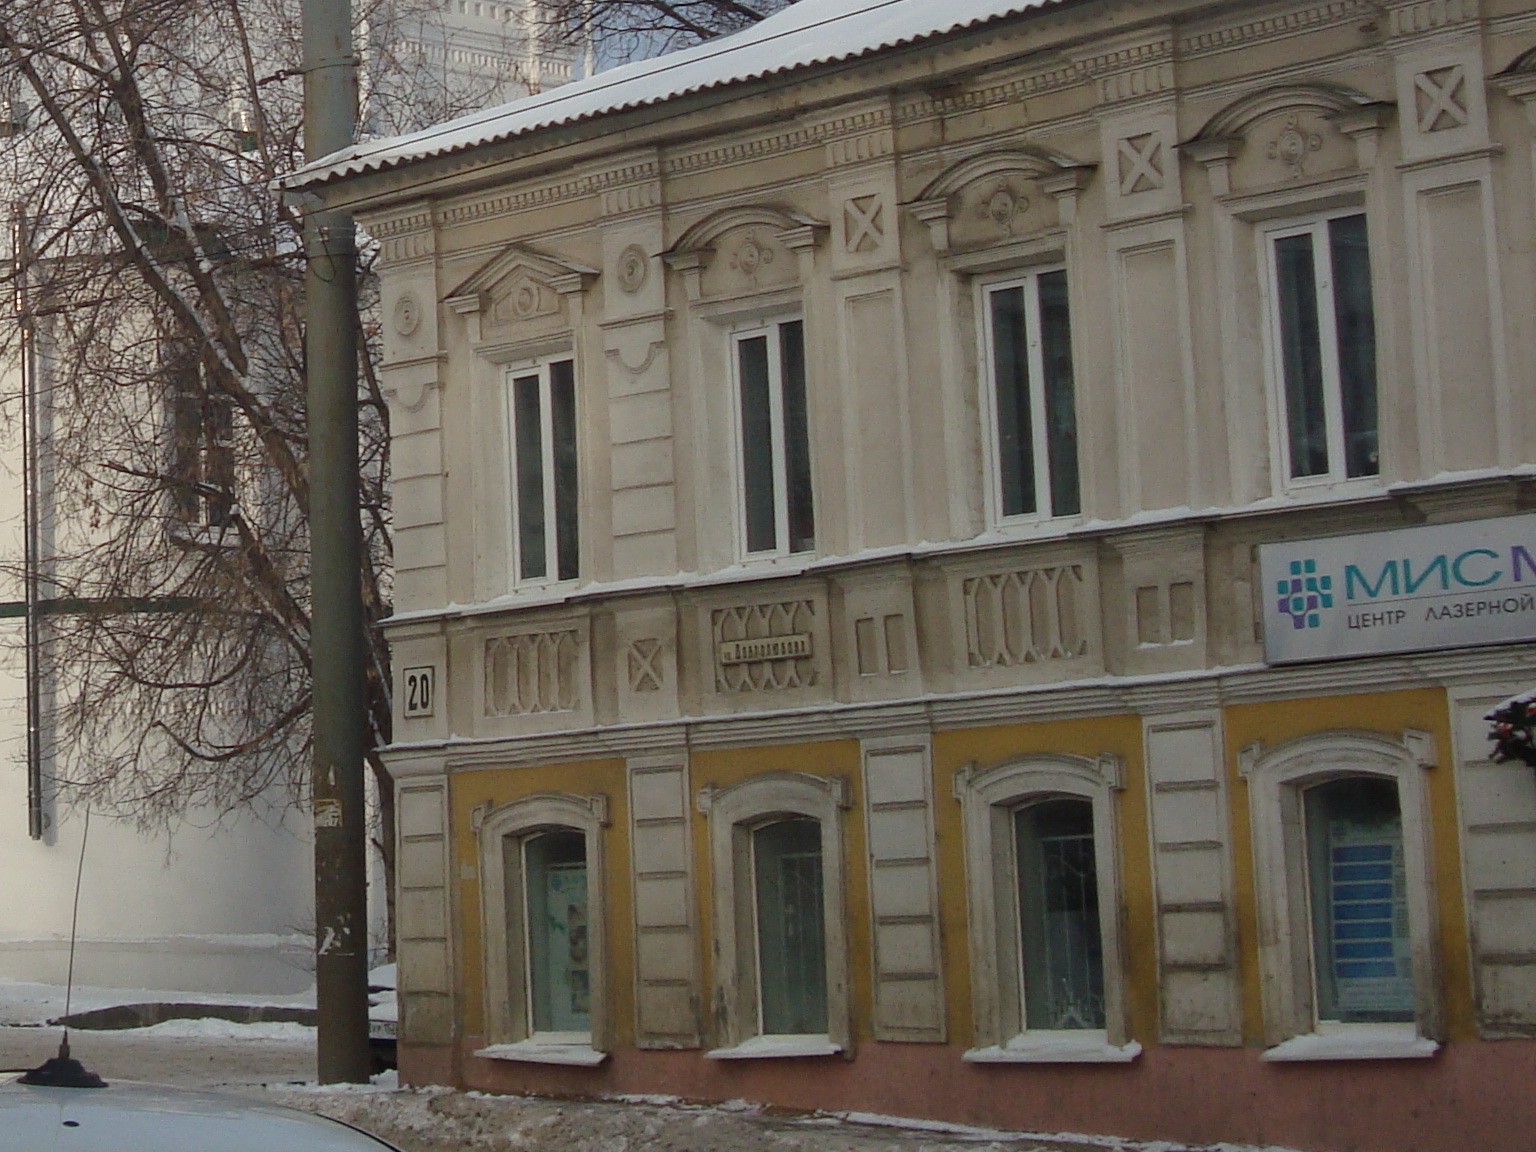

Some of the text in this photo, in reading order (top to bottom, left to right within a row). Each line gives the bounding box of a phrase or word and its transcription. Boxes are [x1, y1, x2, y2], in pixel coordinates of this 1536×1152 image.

[1348, 593, 1535, 630] ЦЕНТР ЛАЗЕРНОЙ
[408, 674, 429, 711] 20
